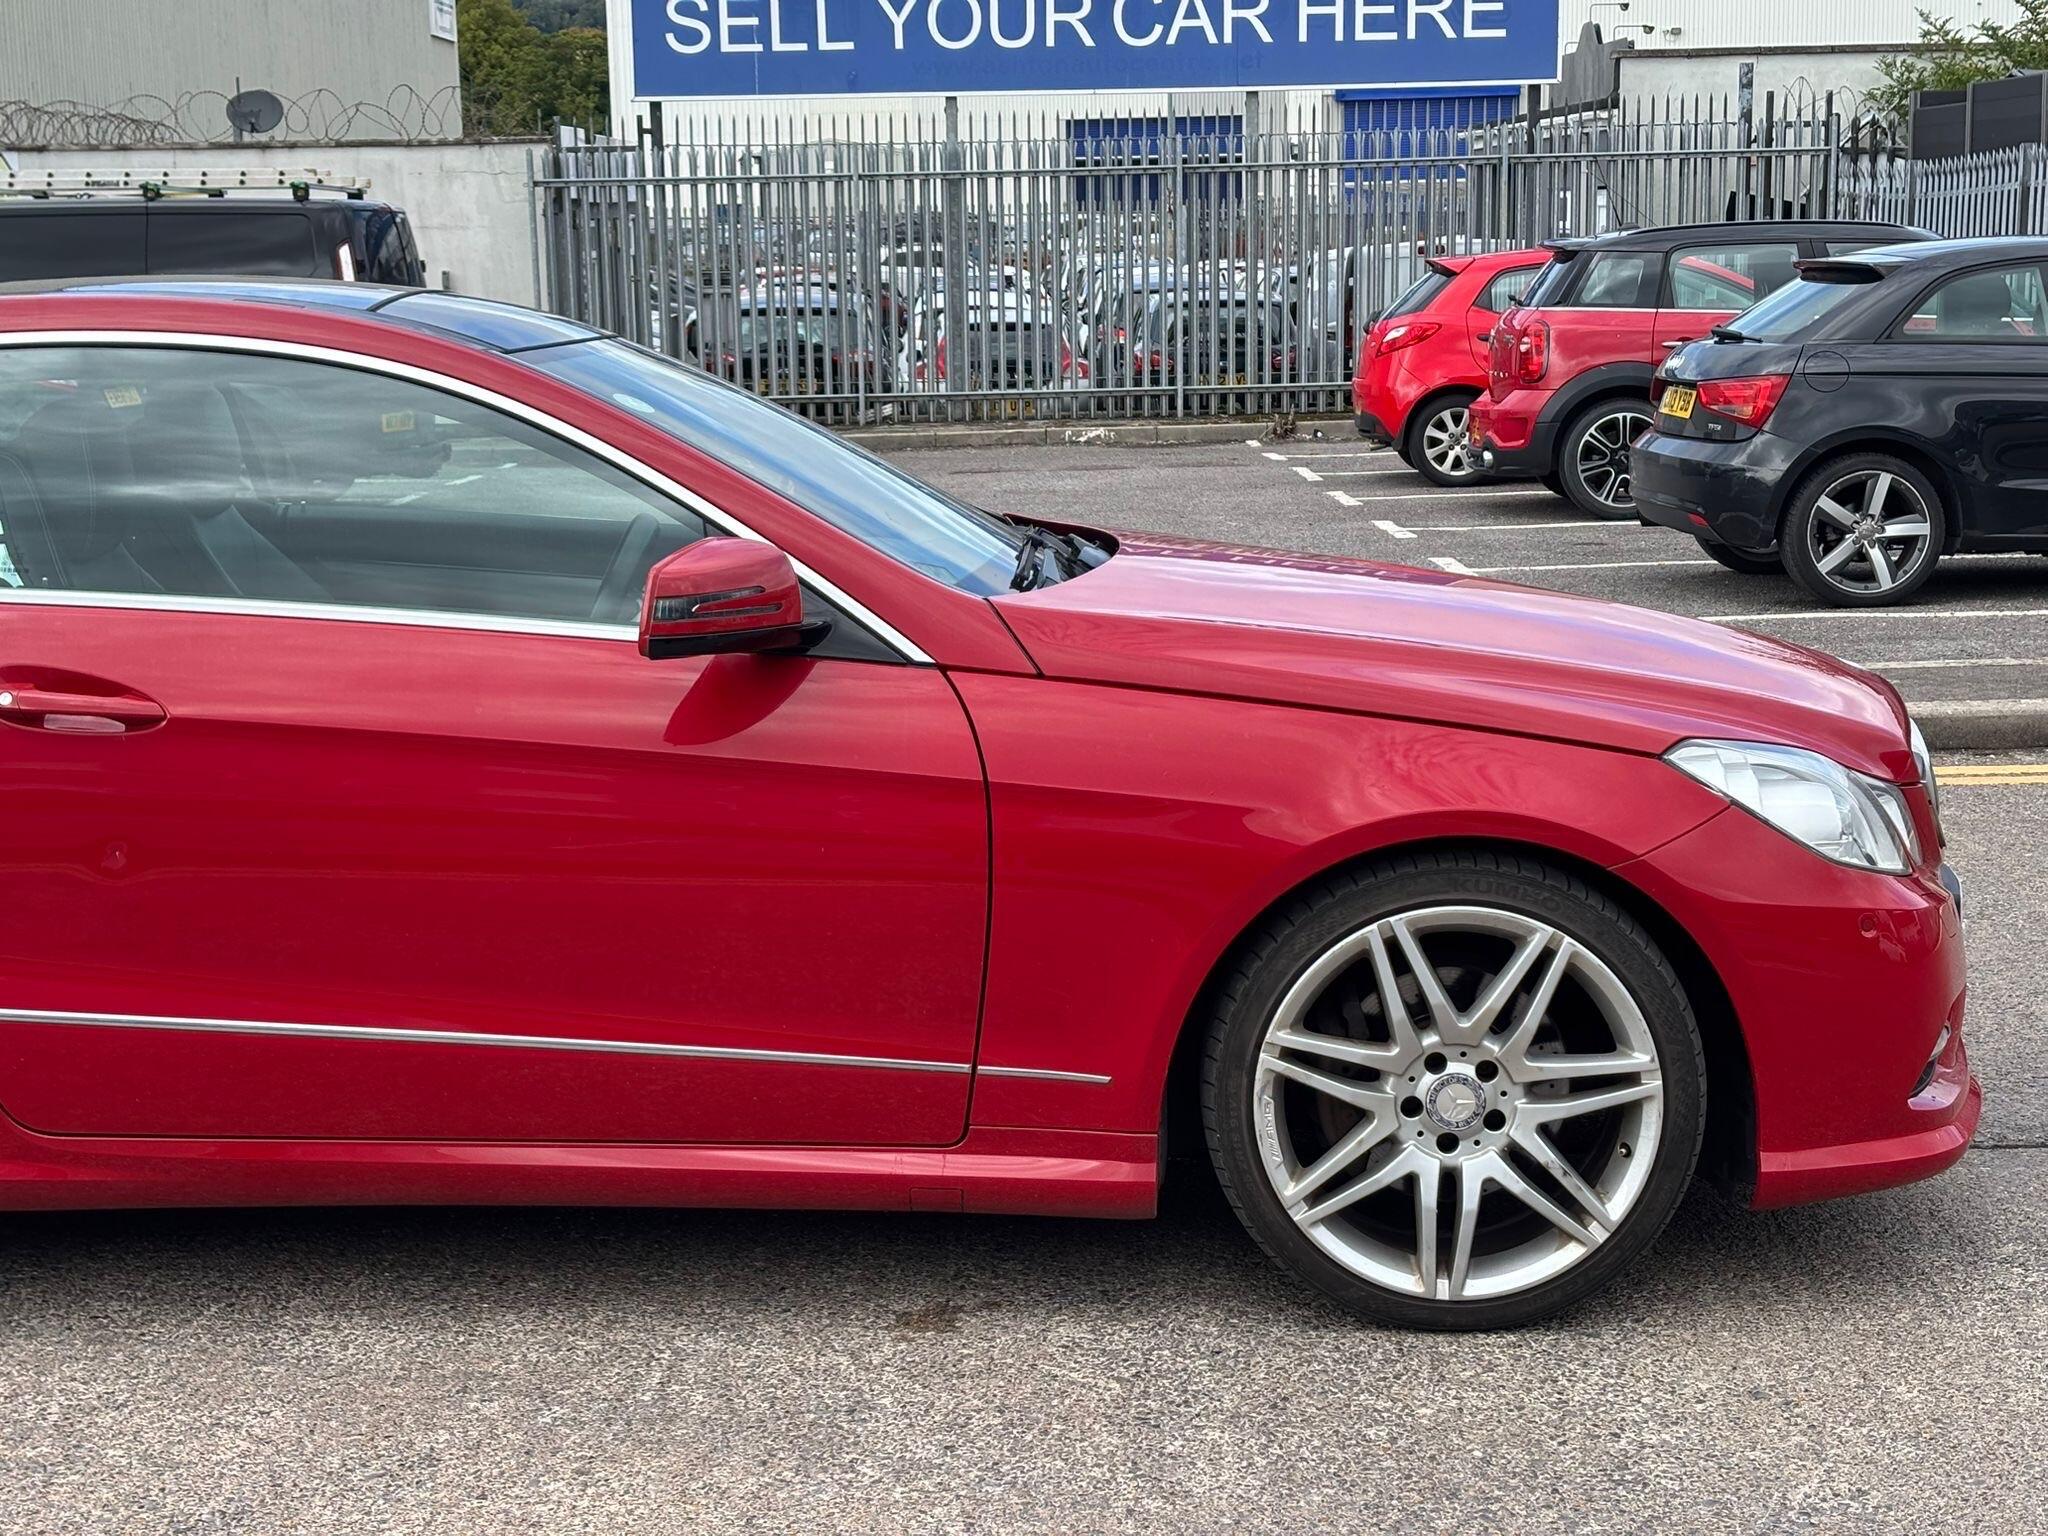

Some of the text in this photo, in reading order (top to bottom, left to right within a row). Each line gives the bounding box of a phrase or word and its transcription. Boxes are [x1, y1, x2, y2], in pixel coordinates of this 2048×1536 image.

[665, 0, 1507, 54] SELL YOUR CAR HERE
[1454, 877, 1563, 913] KUMHO
